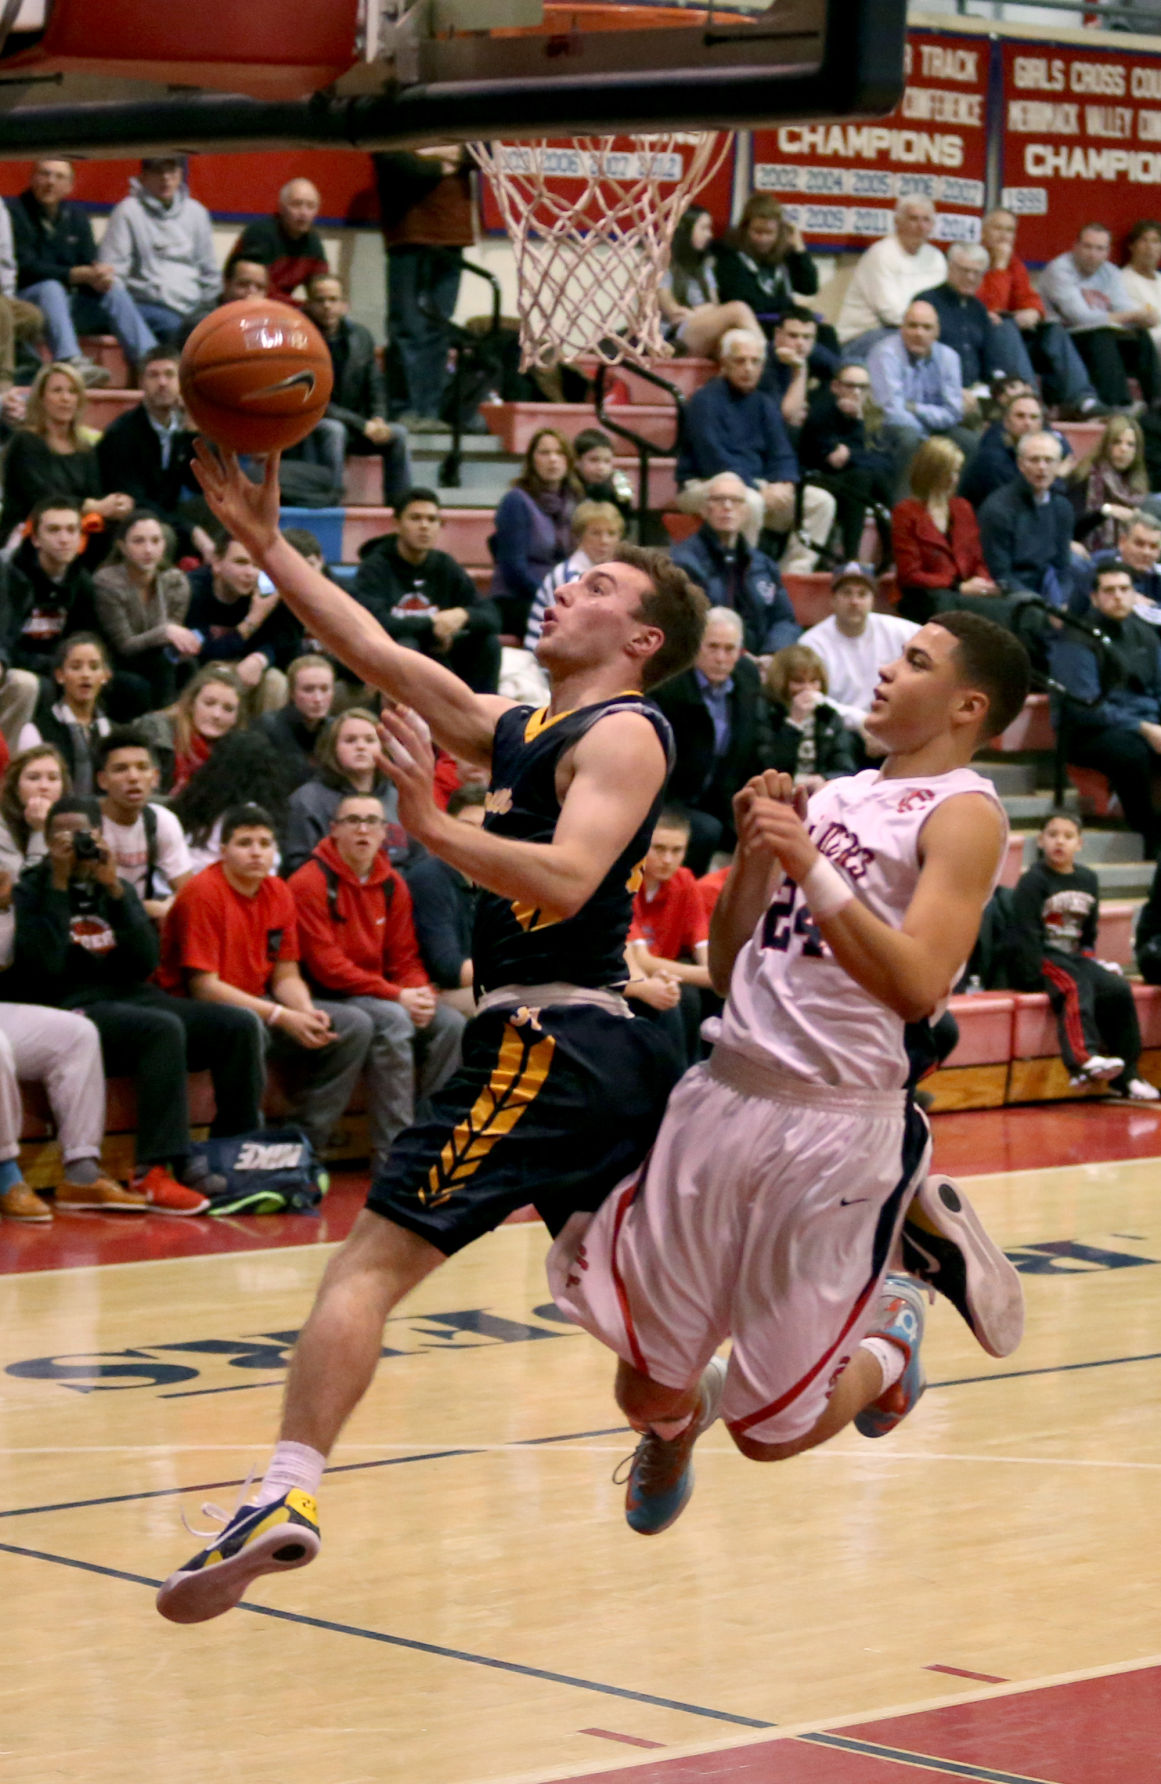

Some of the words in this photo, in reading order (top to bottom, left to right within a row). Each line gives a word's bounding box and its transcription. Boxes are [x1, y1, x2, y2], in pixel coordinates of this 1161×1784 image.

[919, 45, 978, 82] TRACK
[1014, 56, 1065, 91] GIRLS
[1070, 61, 1126, 96] CROSS
[777, 126, 964, 168] CHAMPIONS
[806, 168, 843, 191] 2004
[941, 215, 976, 239] 2014
